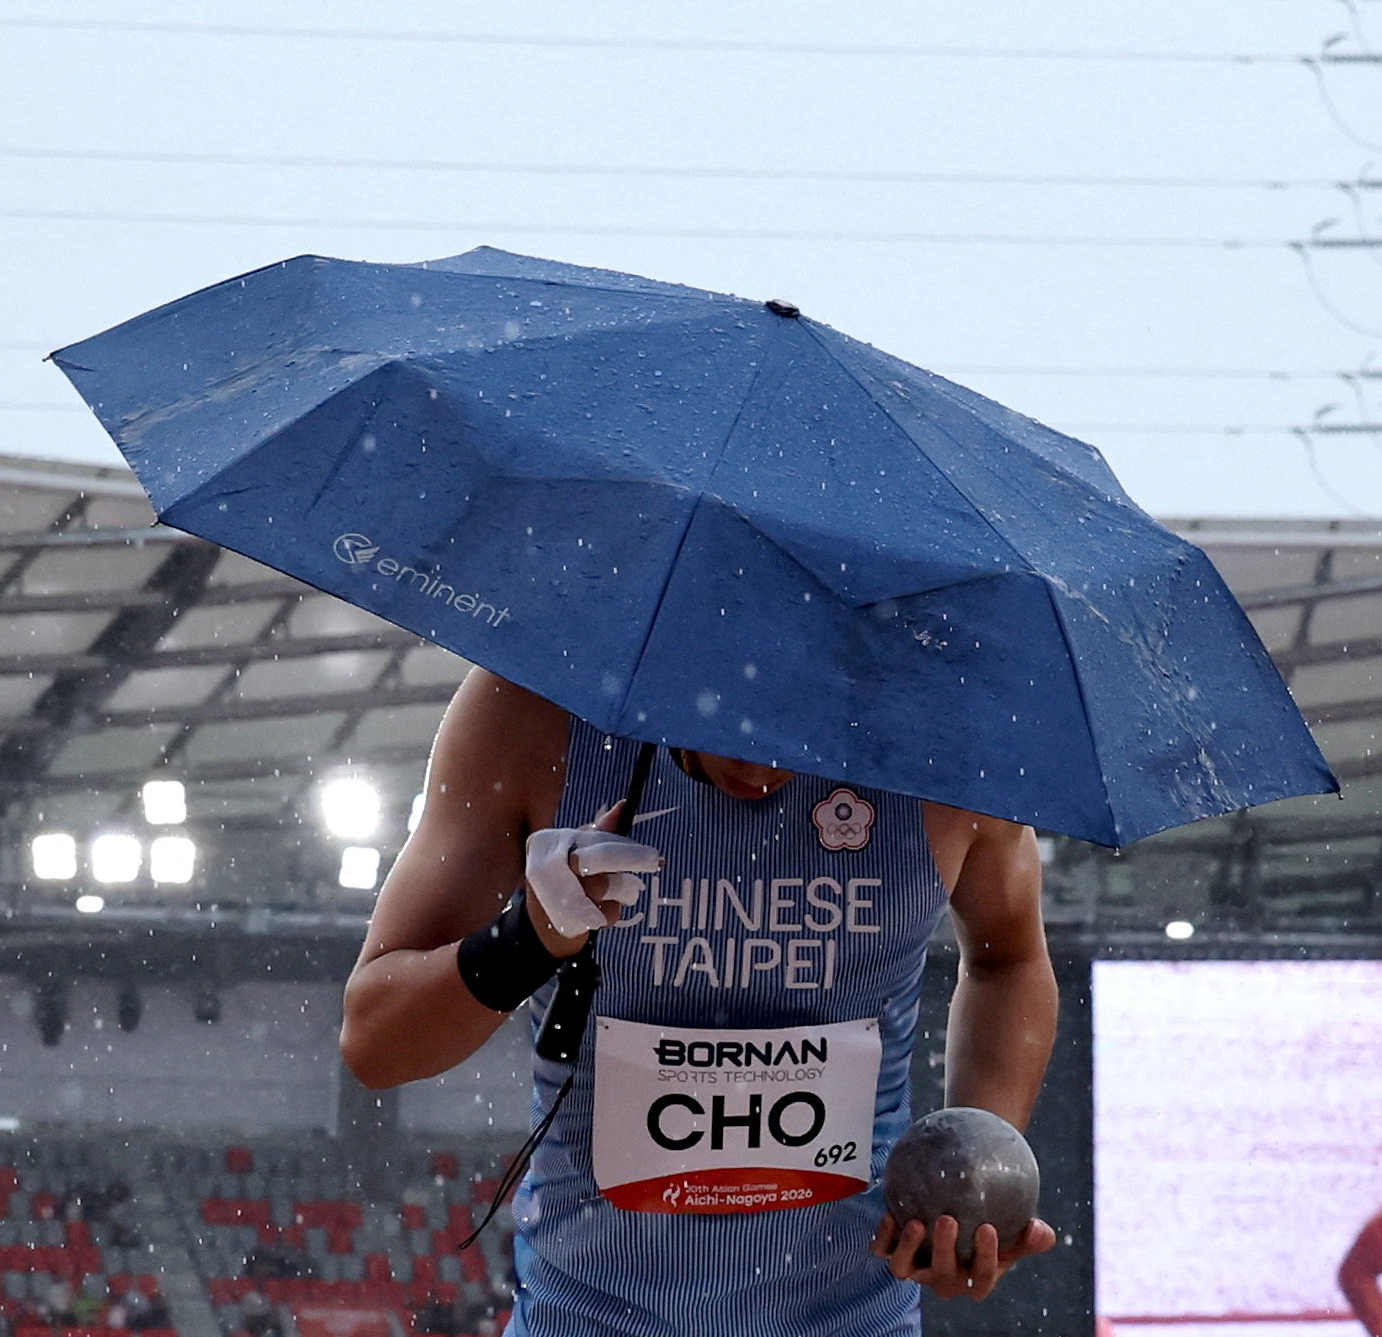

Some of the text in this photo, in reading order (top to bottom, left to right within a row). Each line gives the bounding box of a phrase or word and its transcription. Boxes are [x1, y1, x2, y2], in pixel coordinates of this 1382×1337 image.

[377, 557, 511, 628] eminent
[640, 935, 837, 990] TAIPEI
[653, 1037, 828, 1068] BORNAN
[657, 1067, 826, 1084] SPORTS TECHNOLOGY
[646, 1091, 827, 1151] CHO
[813, 1141, 858, 1168] 692
[684, 1188, 813, 1207] Aichi-Nagoya 2026
